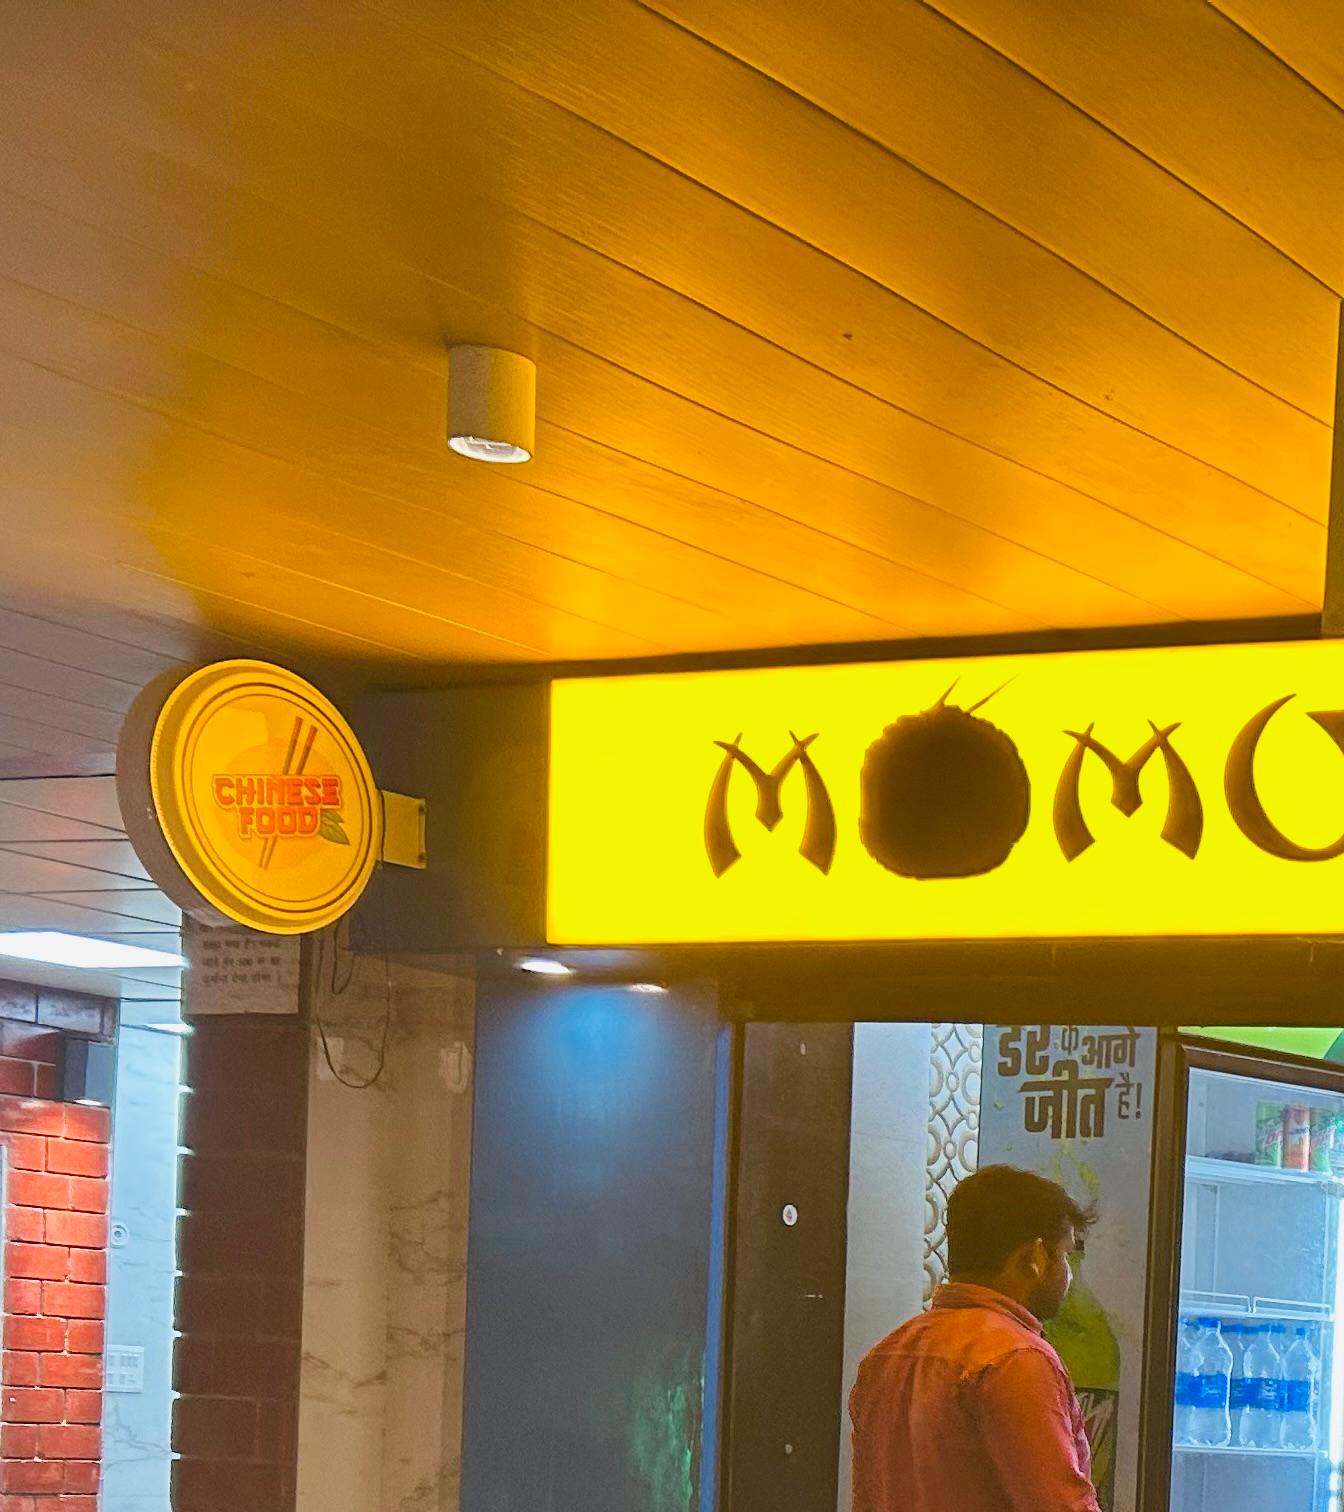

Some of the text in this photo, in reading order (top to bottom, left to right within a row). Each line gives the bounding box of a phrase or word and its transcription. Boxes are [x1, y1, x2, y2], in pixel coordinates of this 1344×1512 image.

[213, 775, 340, 808] CHINESE
[238, 807, 320, 838] FOOD
[998, 1026, 1051, 1077] डर
[1081, 1027, 1141, 1069] आगे
[1019, 1059, 1143, 1139] जीत है!
